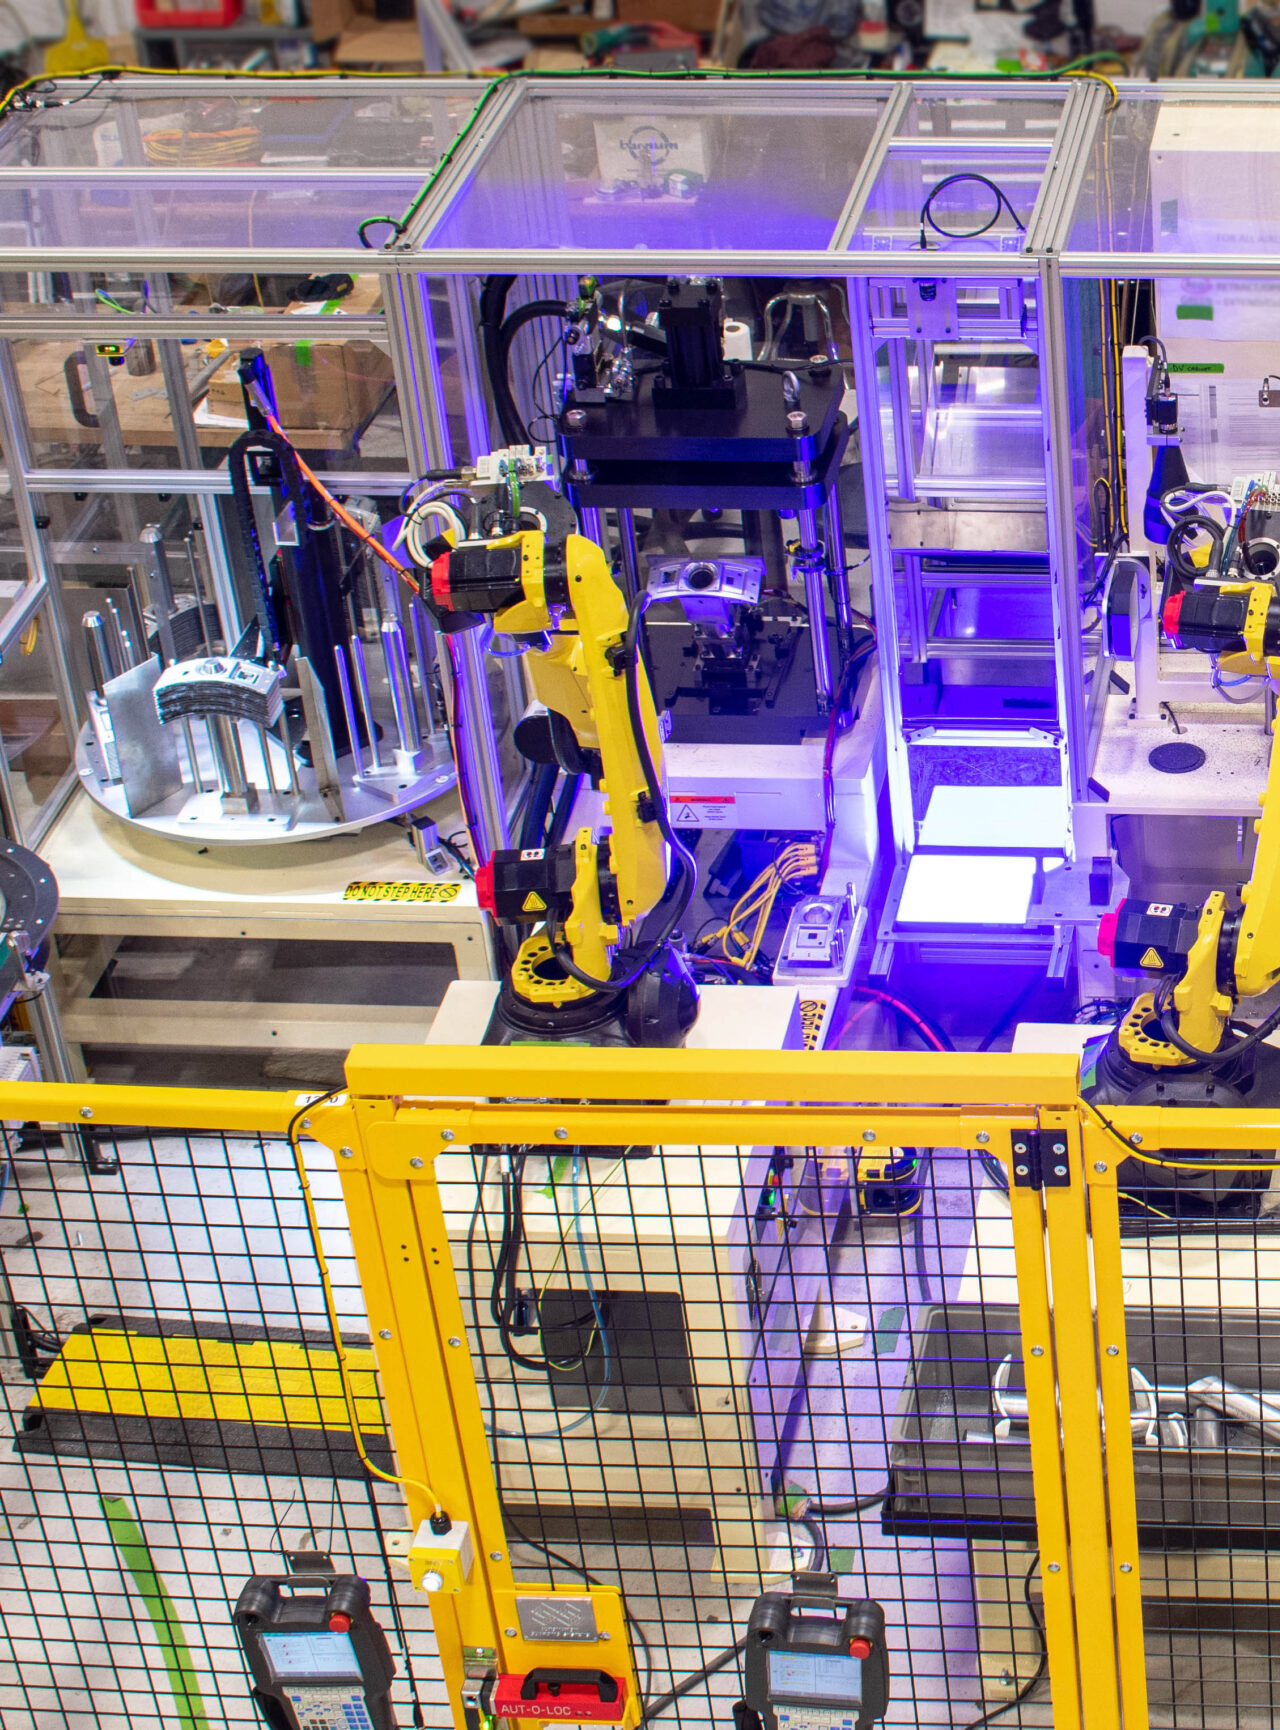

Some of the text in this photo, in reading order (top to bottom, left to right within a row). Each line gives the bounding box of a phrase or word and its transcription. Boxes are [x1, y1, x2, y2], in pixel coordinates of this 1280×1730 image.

[344, 885, 439, 899] DO NOT STEP HERE
[501, 1704, 571, 1716] AUT-O-LOC
